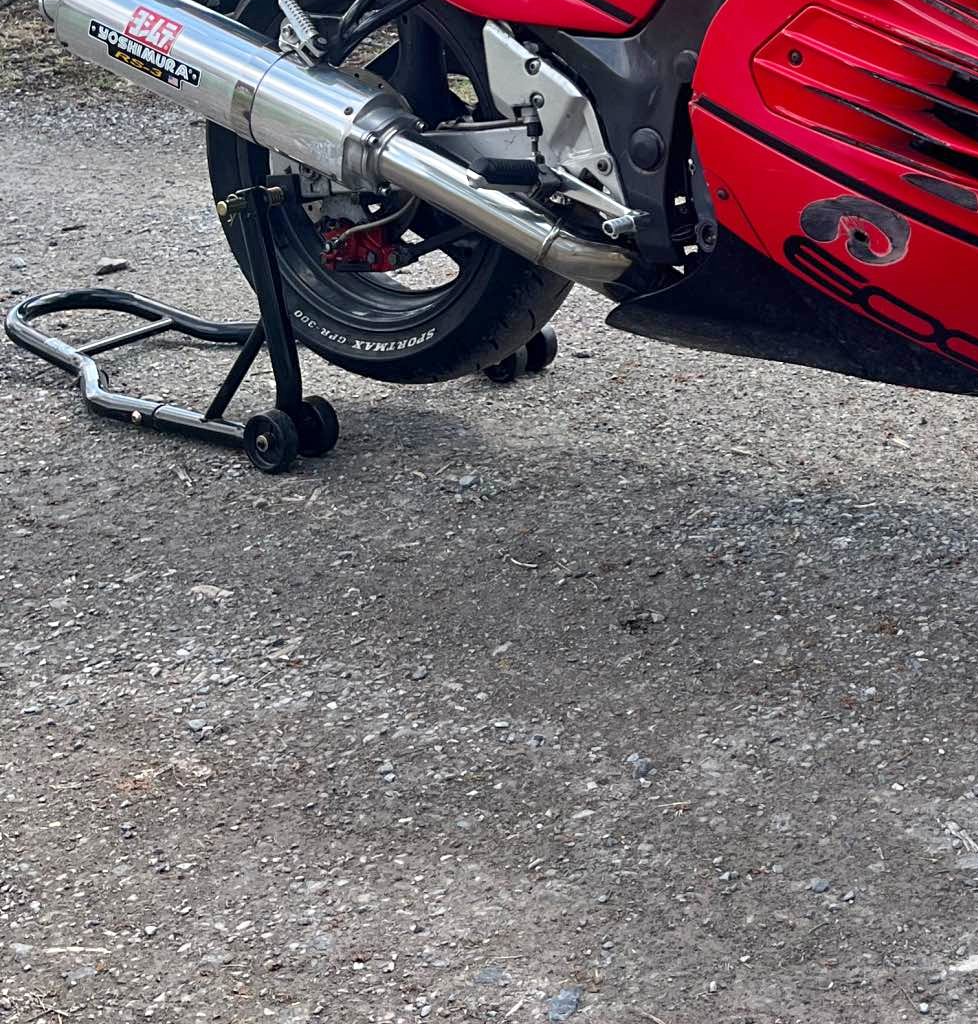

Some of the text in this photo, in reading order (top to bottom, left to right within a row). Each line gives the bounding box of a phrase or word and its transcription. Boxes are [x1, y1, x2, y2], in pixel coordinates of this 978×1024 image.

[98, 25, 190, 81] YOSHIMURA
[114, 50, 163, 78] RS-3
[293, 309, 436, 352] SPORTMAX GPR-300
